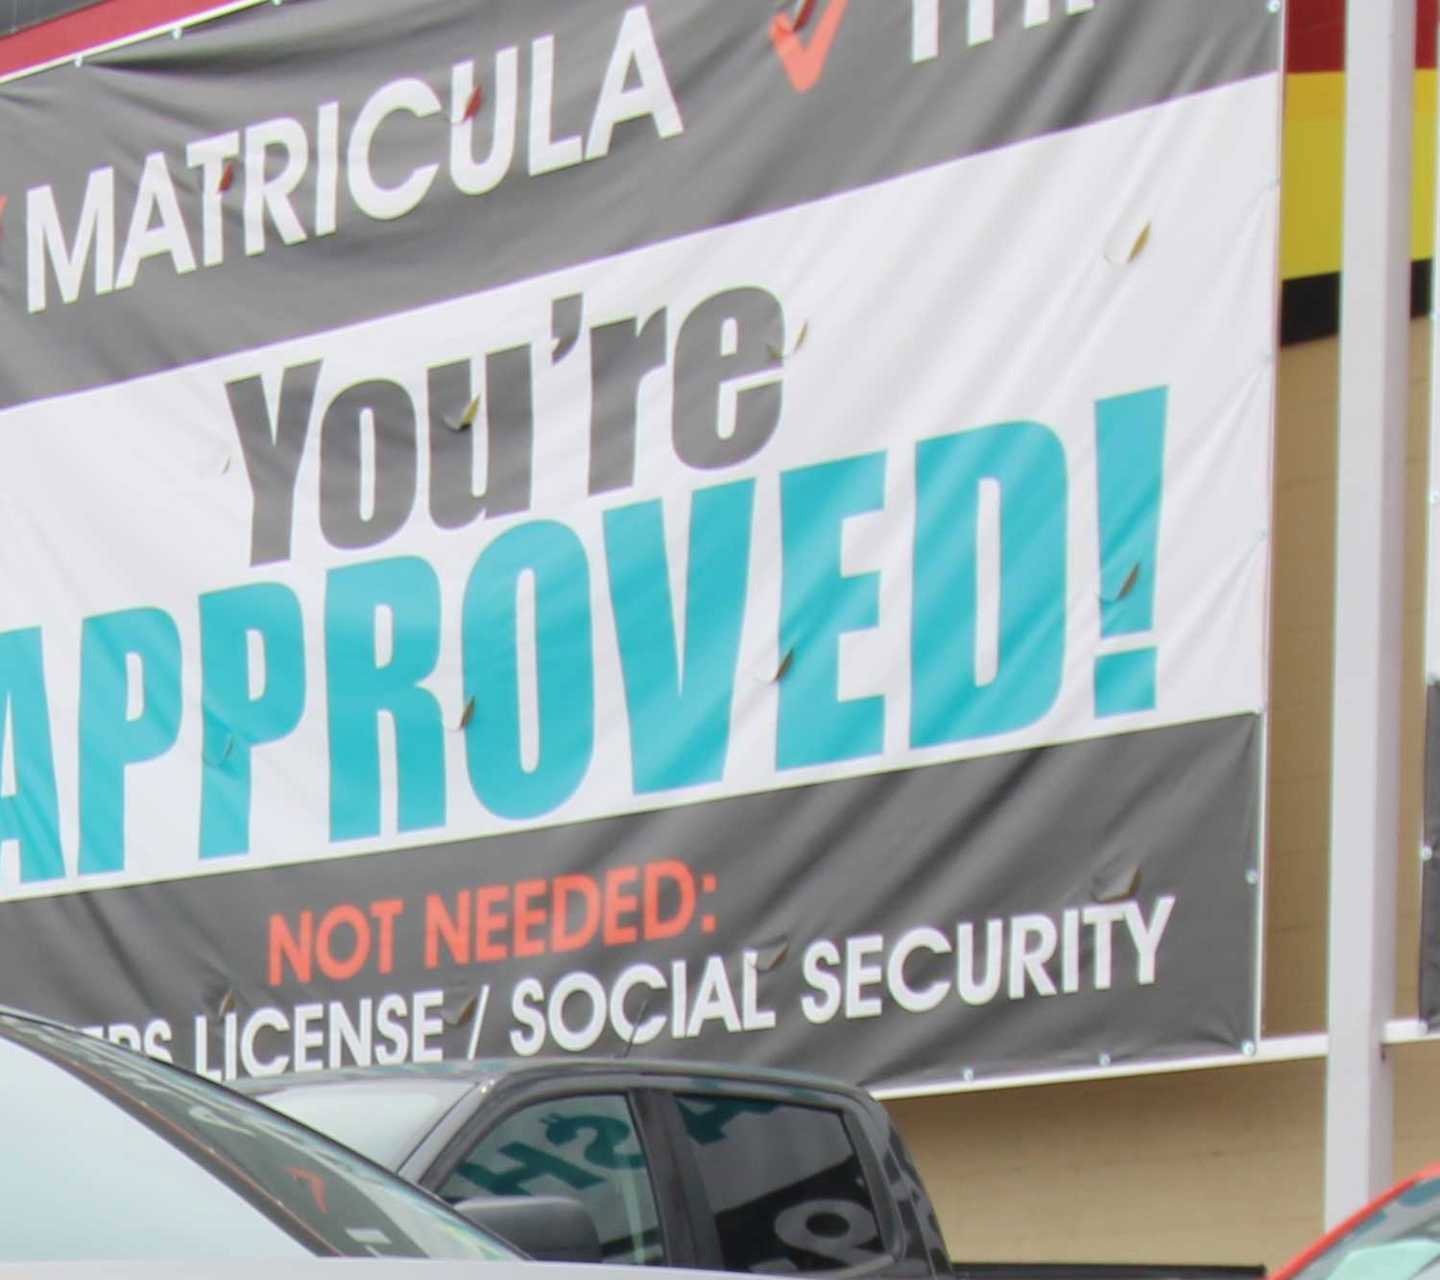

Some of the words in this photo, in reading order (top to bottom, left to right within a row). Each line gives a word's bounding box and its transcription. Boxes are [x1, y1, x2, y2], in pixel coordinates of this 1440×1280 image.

[25, 8, 683, 312] MATRICULA
[224, 285, 785, 566] You're
[195, 985, 445, 1080] LICENSE
[510, 944, 776, 1055] SOCIAL
[802, 896, 1176, 1016] SECURITY
[267, 899, 405, 986] NOT
[425, 860, 717, 965] NEEDED:
